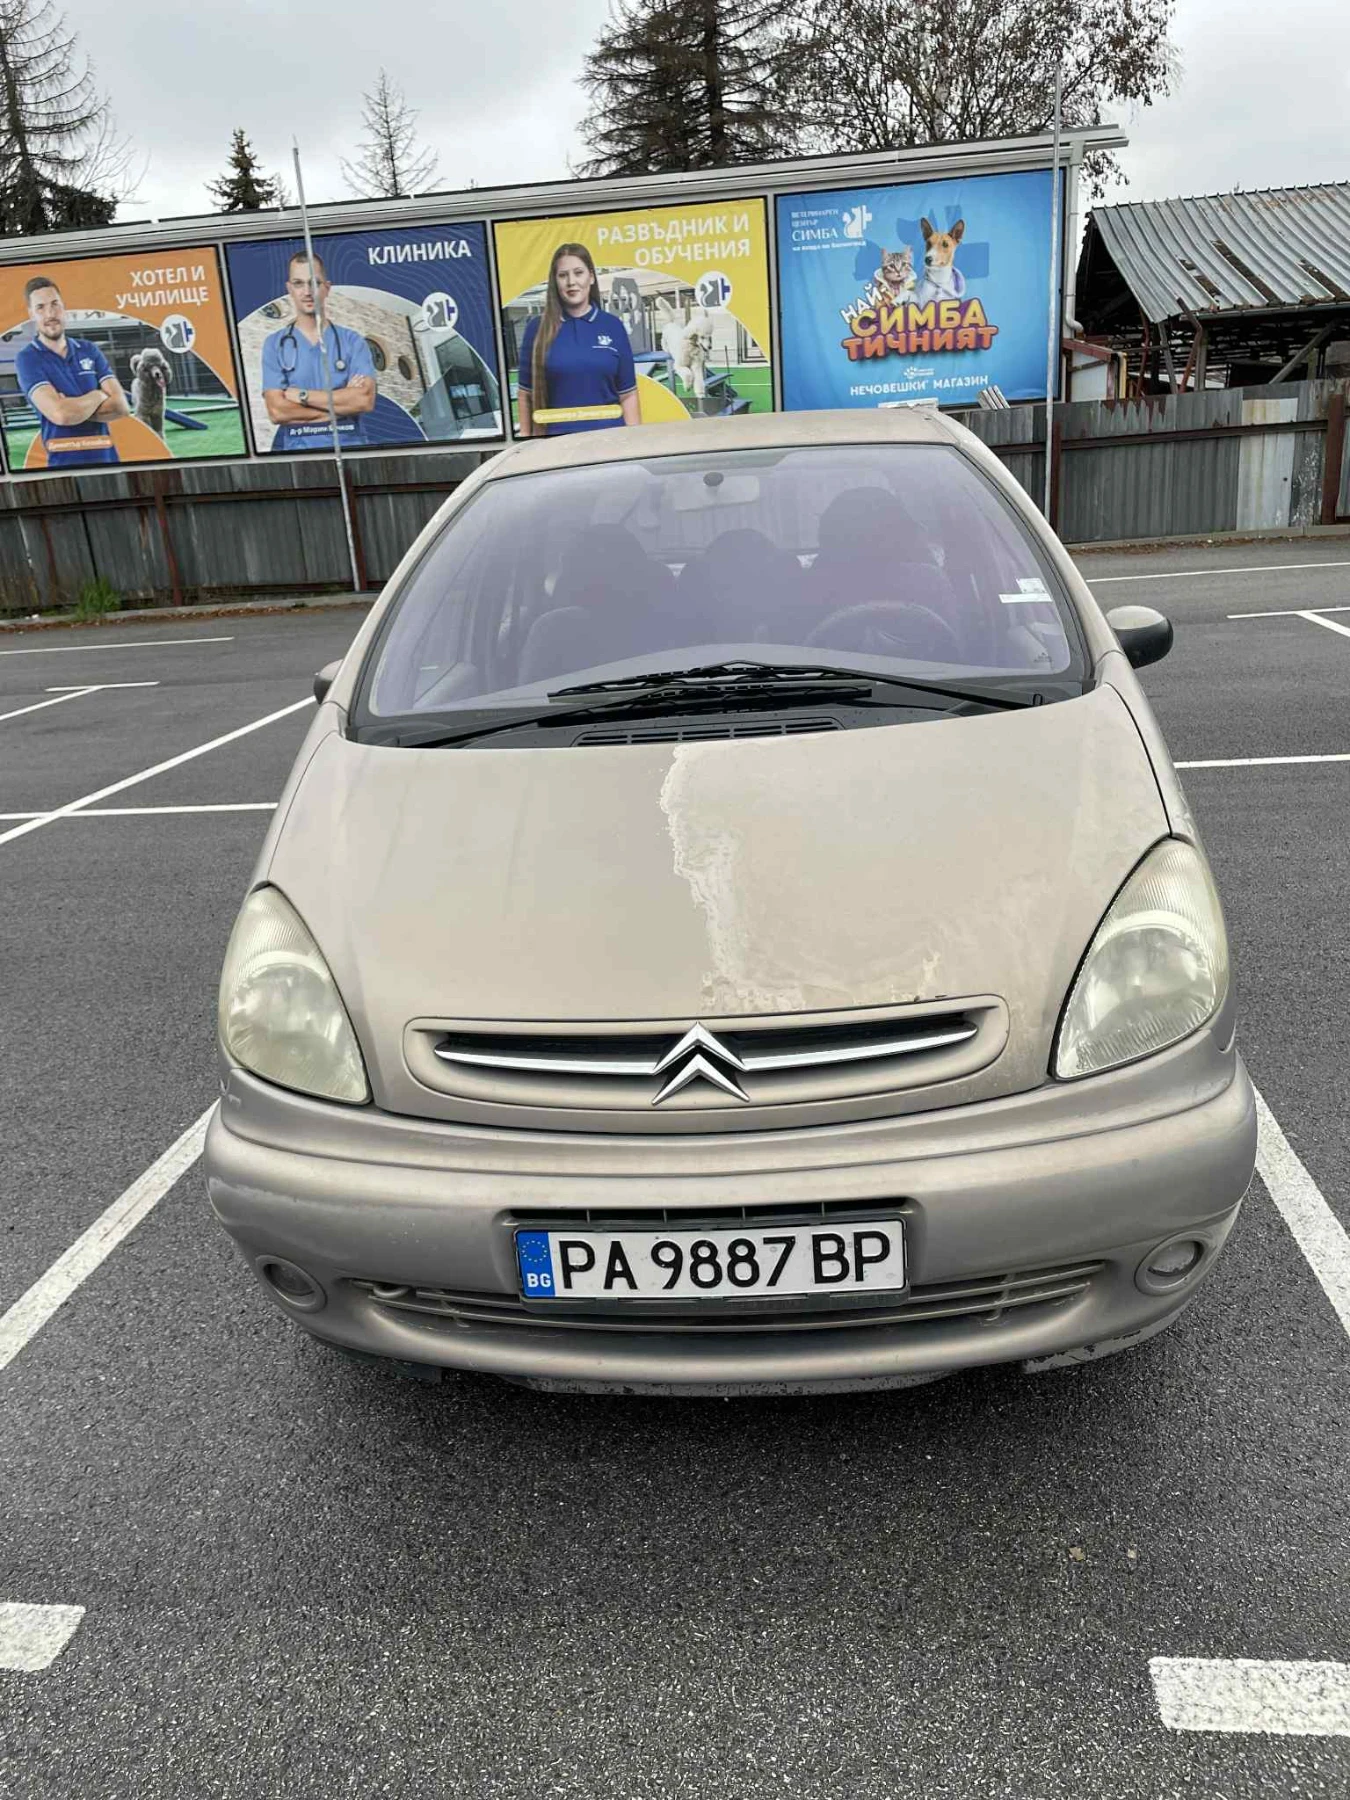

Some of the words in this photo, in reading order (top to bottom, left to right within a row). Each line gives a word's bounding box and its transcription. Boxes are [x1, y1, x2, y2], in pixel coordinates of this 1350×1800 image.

[597, 215, 728, 246] РАЗВЪДНИК
[733, 212, 750, 233] И
[791, 227, 839, 242] СИМБА
[367, 239, 472, 265] КЛИНИКА
[635, 238, 751, 266] ОБУЧЕНИЯ
[129, 267, 188, 288] ХОТЕЛ
[191, 265, 205, 281] И
[115, 286, 210, 310] УЧИЛИЩЕ
[851, 298, 987, 338] СИМБА
[843, 326, 998, 360] ТИЧНИЯТ
[933, 375, 989, 390] МАГАЗИН
[559, 1240, 638, 1290] PA
[650, 1235, 797, 1290] 9887
[811, 1230, 891, 1285] BP
[526, 1272, 552, 1288] BG
